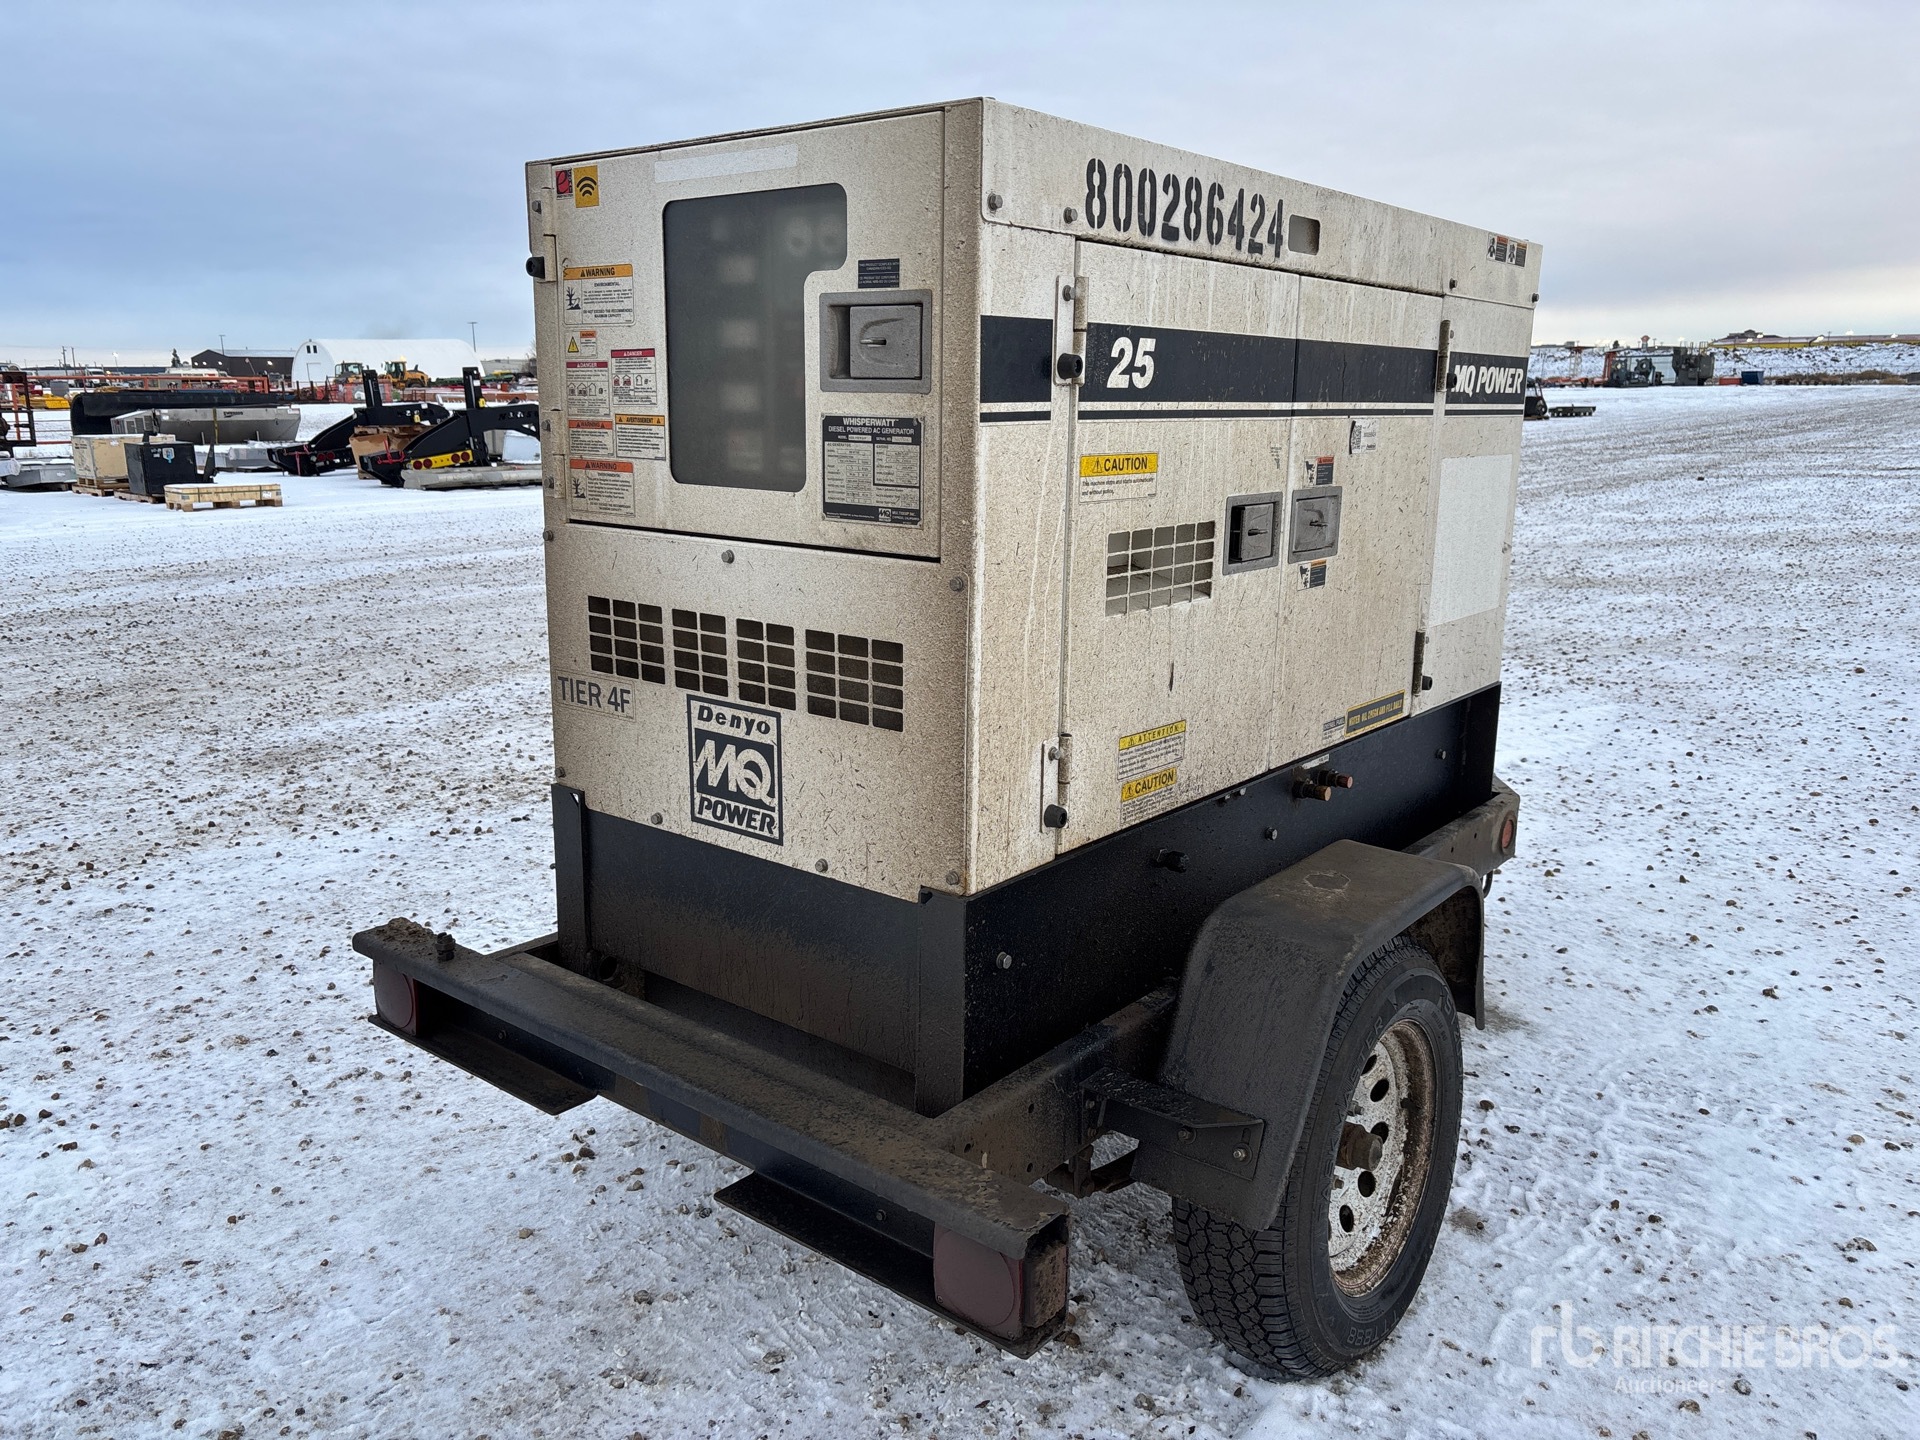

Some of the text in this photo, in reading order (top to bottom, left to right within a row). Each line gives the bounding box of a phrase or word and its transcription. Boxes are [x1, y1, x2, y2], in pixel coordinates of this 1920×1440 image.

[1085, 158, 1283, 258] 800286424
[586, 267, 615, 277] WARNING
[1107, 337, 1156, 389] 25
[1452, 365, 1524, 397] MQ POWER
[828, 425, 846, 433] DIESEL
[846, 426, 872, 434] POWERED
[881, 427, 915, 435] GENERATOR
[842, 417, 896, 427] WHISPERWATT
[591, 462, 617, 470] WARNING
[1104, 456, 1148, 471] CAUTION
[558, 676, 630, 713] TIER 4F
[698, 705, 770, 735] Denyo
[1139, 724, 1178, 743] ATTENTION
[695, 739, 775, 808] MQ
[1135, 773, 1174, 794] CAUTION
[698, 796, 776, 835] POWER
